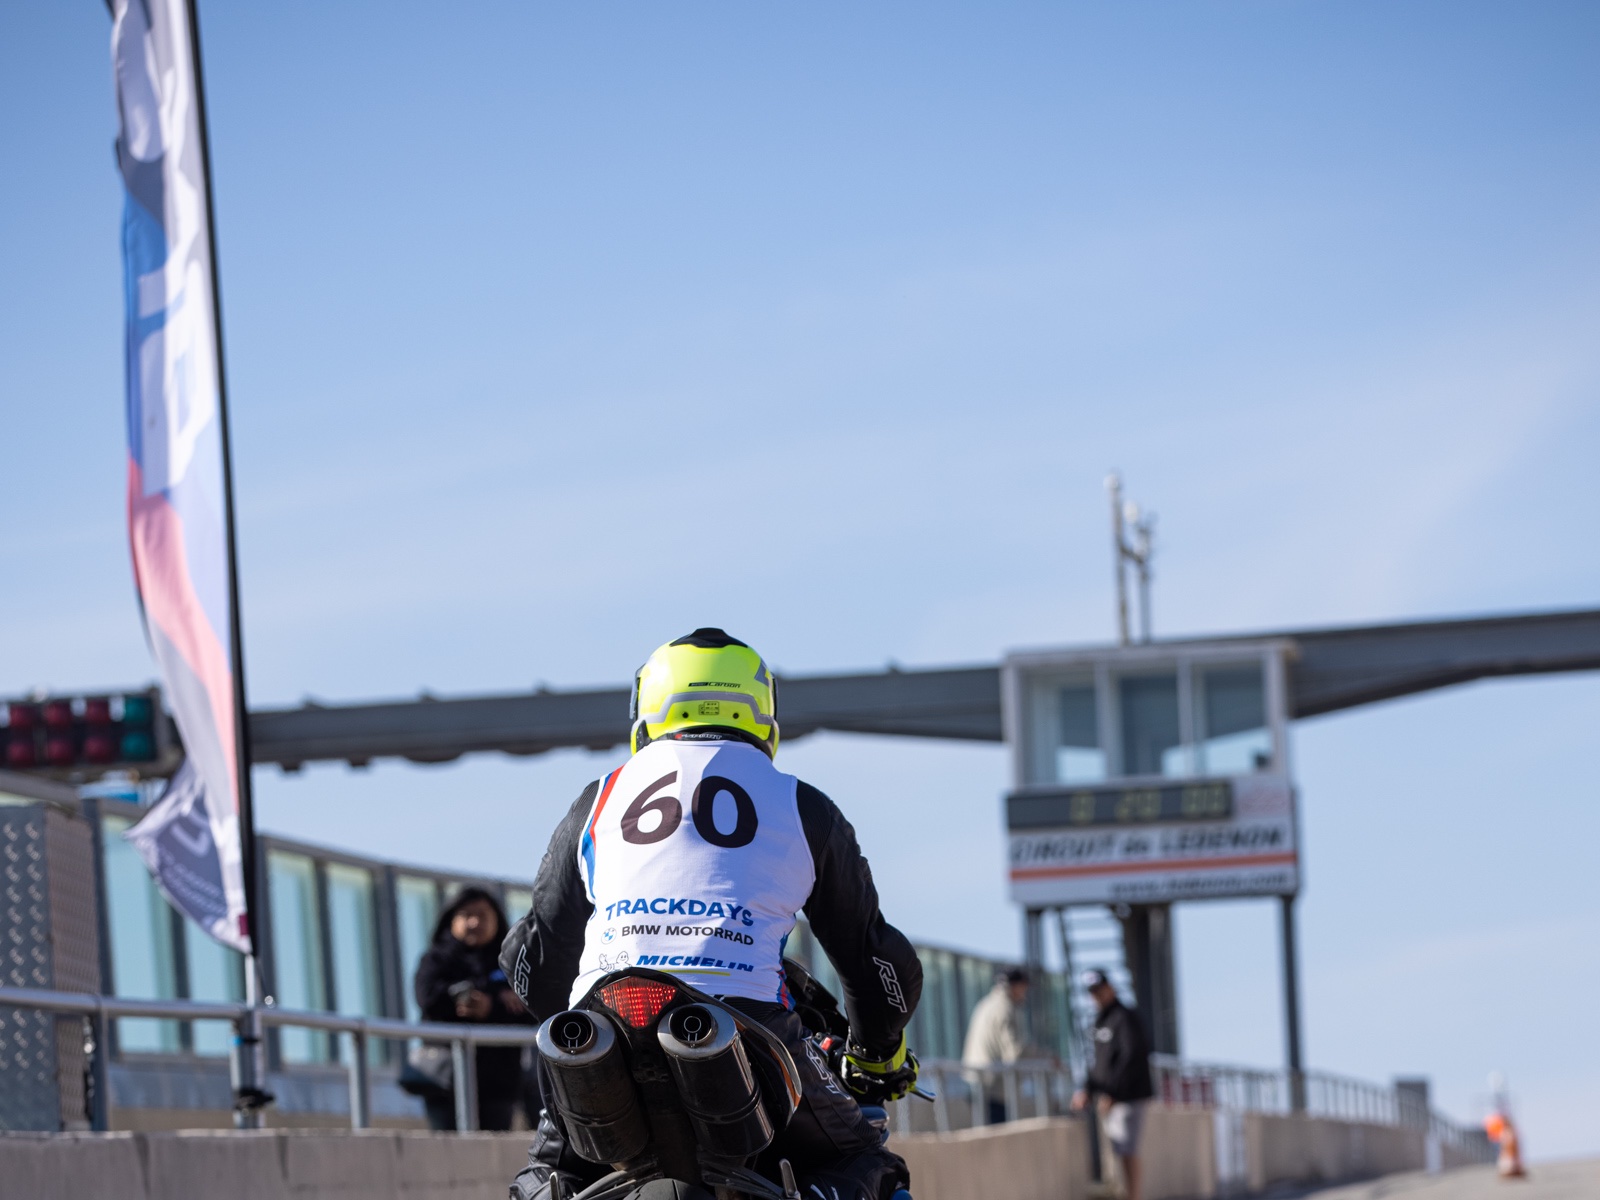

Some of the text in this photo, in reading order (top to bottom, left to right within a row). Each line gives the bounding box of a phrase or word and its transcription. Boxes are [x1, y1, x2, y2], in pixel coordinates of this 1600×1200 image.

[620, 770, 758, 848] 60
[1010, 832, 1114, 862] CIRCUIT
[605, 897, 754, 927] TRACKDAYS
[621, 925, 661, 937] BMW
[665, 926, 754, 946] MOTORRAD
[636, 954, 755, 973] MICHELIN
[872, 956, 908, 1013] RST
